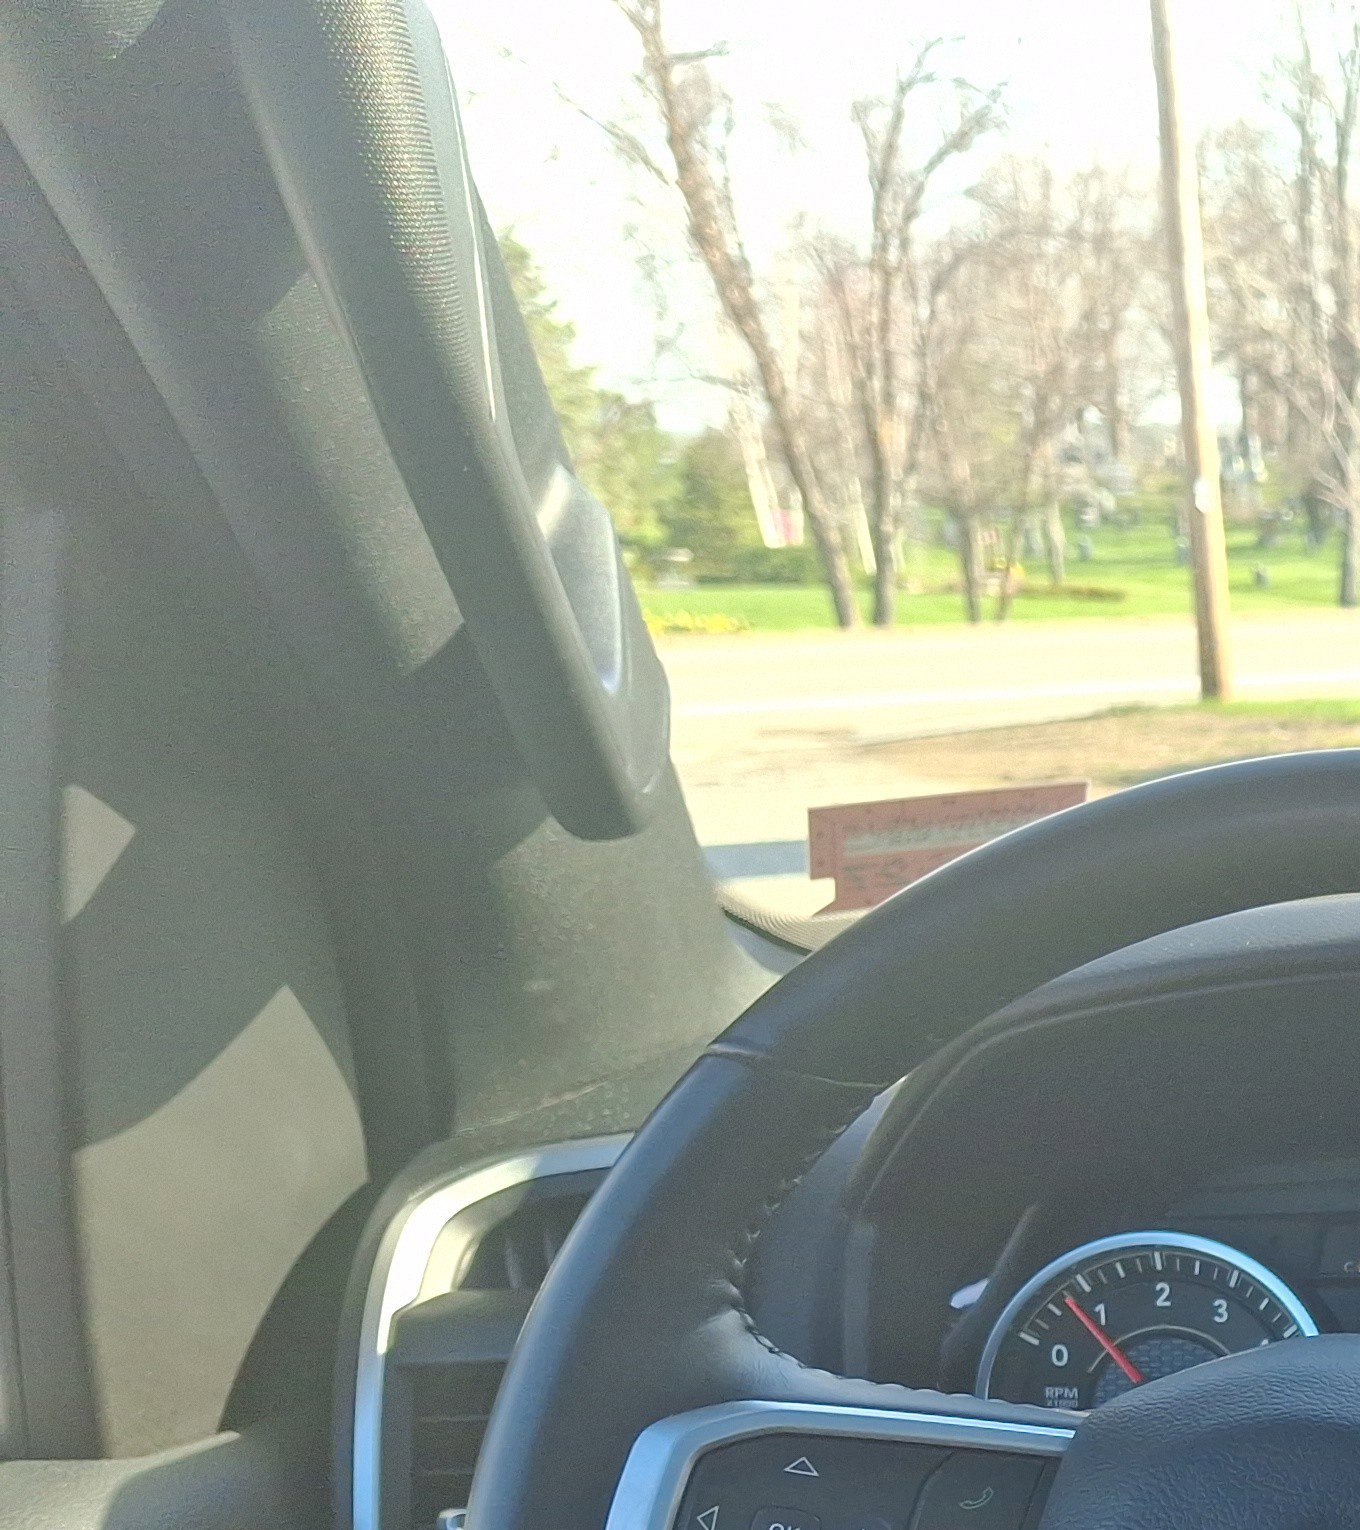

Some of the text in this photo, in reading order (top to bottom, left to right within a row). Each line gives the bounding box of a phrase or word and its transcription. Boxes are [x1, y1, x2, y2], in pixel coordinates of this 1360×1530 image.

[1155, 1281, 1172, 1307] 2
[1094, 1302, 1107, 1326] 1
[1213, 1299, 1229, 1324] 3
[1050, 1344, 1069, 1368] 0
[1045, 1386, 1079, 1400] RPM
